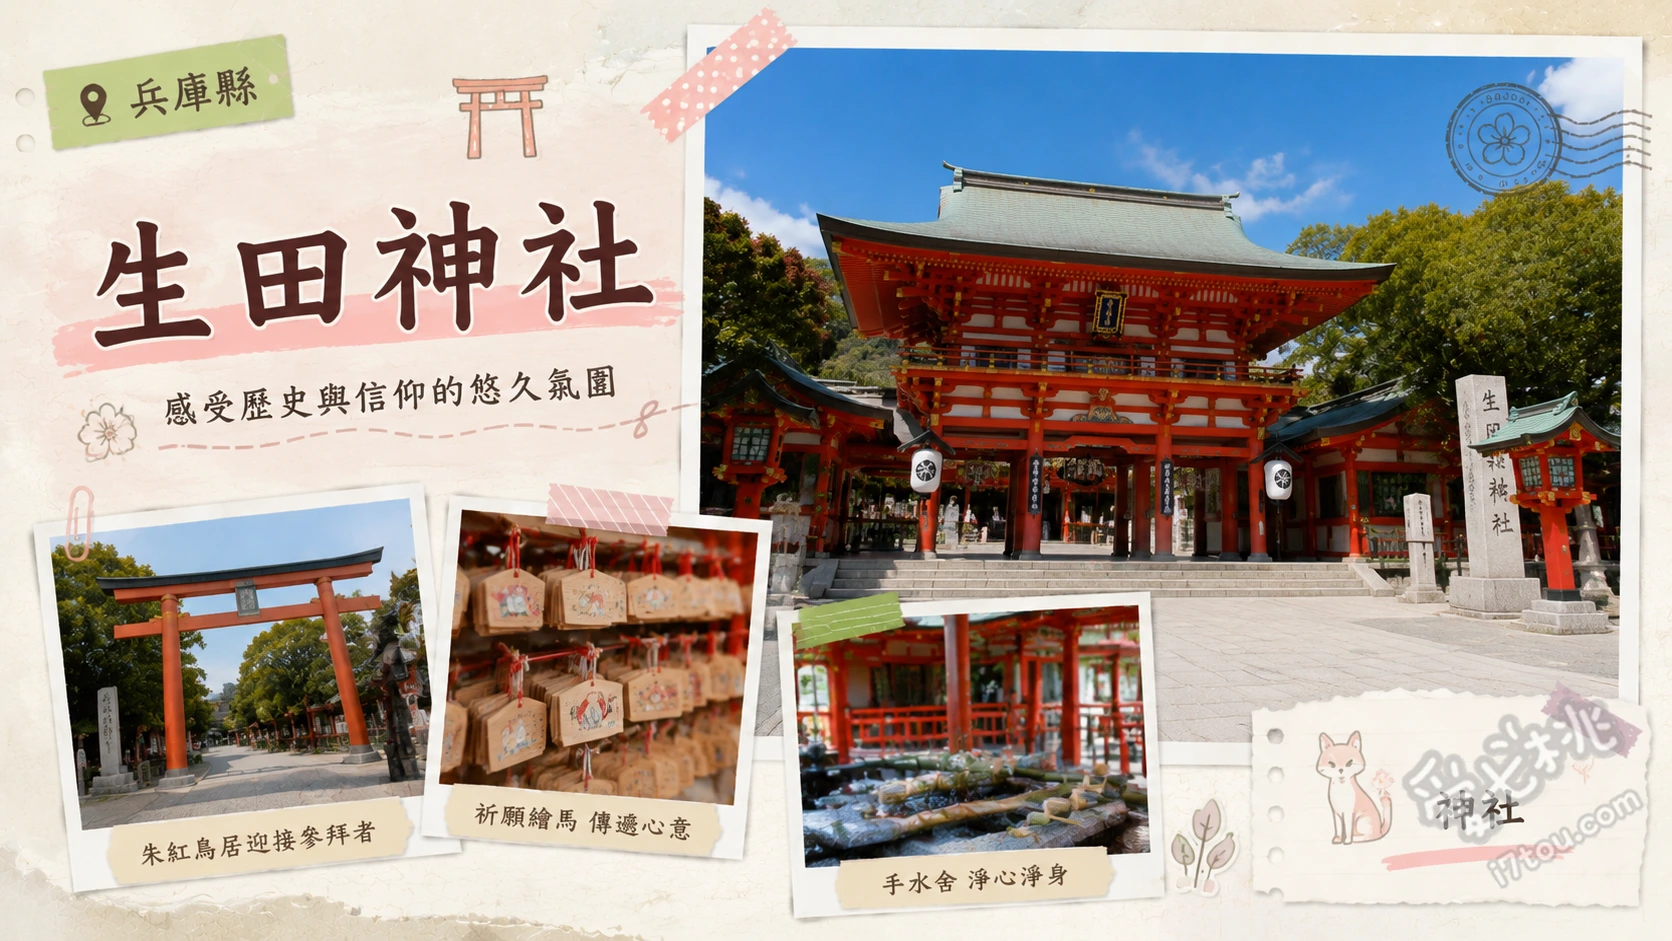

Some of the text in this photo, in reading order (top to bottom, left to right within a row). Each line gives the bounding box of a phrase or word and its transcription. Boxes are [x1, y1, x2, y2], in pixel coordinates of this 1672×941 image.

[130, 66, 258, 119] 兵庫縣
[95, 201, 655, 348] 生田神社
[474, 802, 578, 833] 祈願繪馬
[1435, 788, 1526, 831] 神社
[141, 819, 377, 867] 朱紅鳥居迎接參拜者
[882, 862, 1068, 896] 手水舍 淨心淨身
